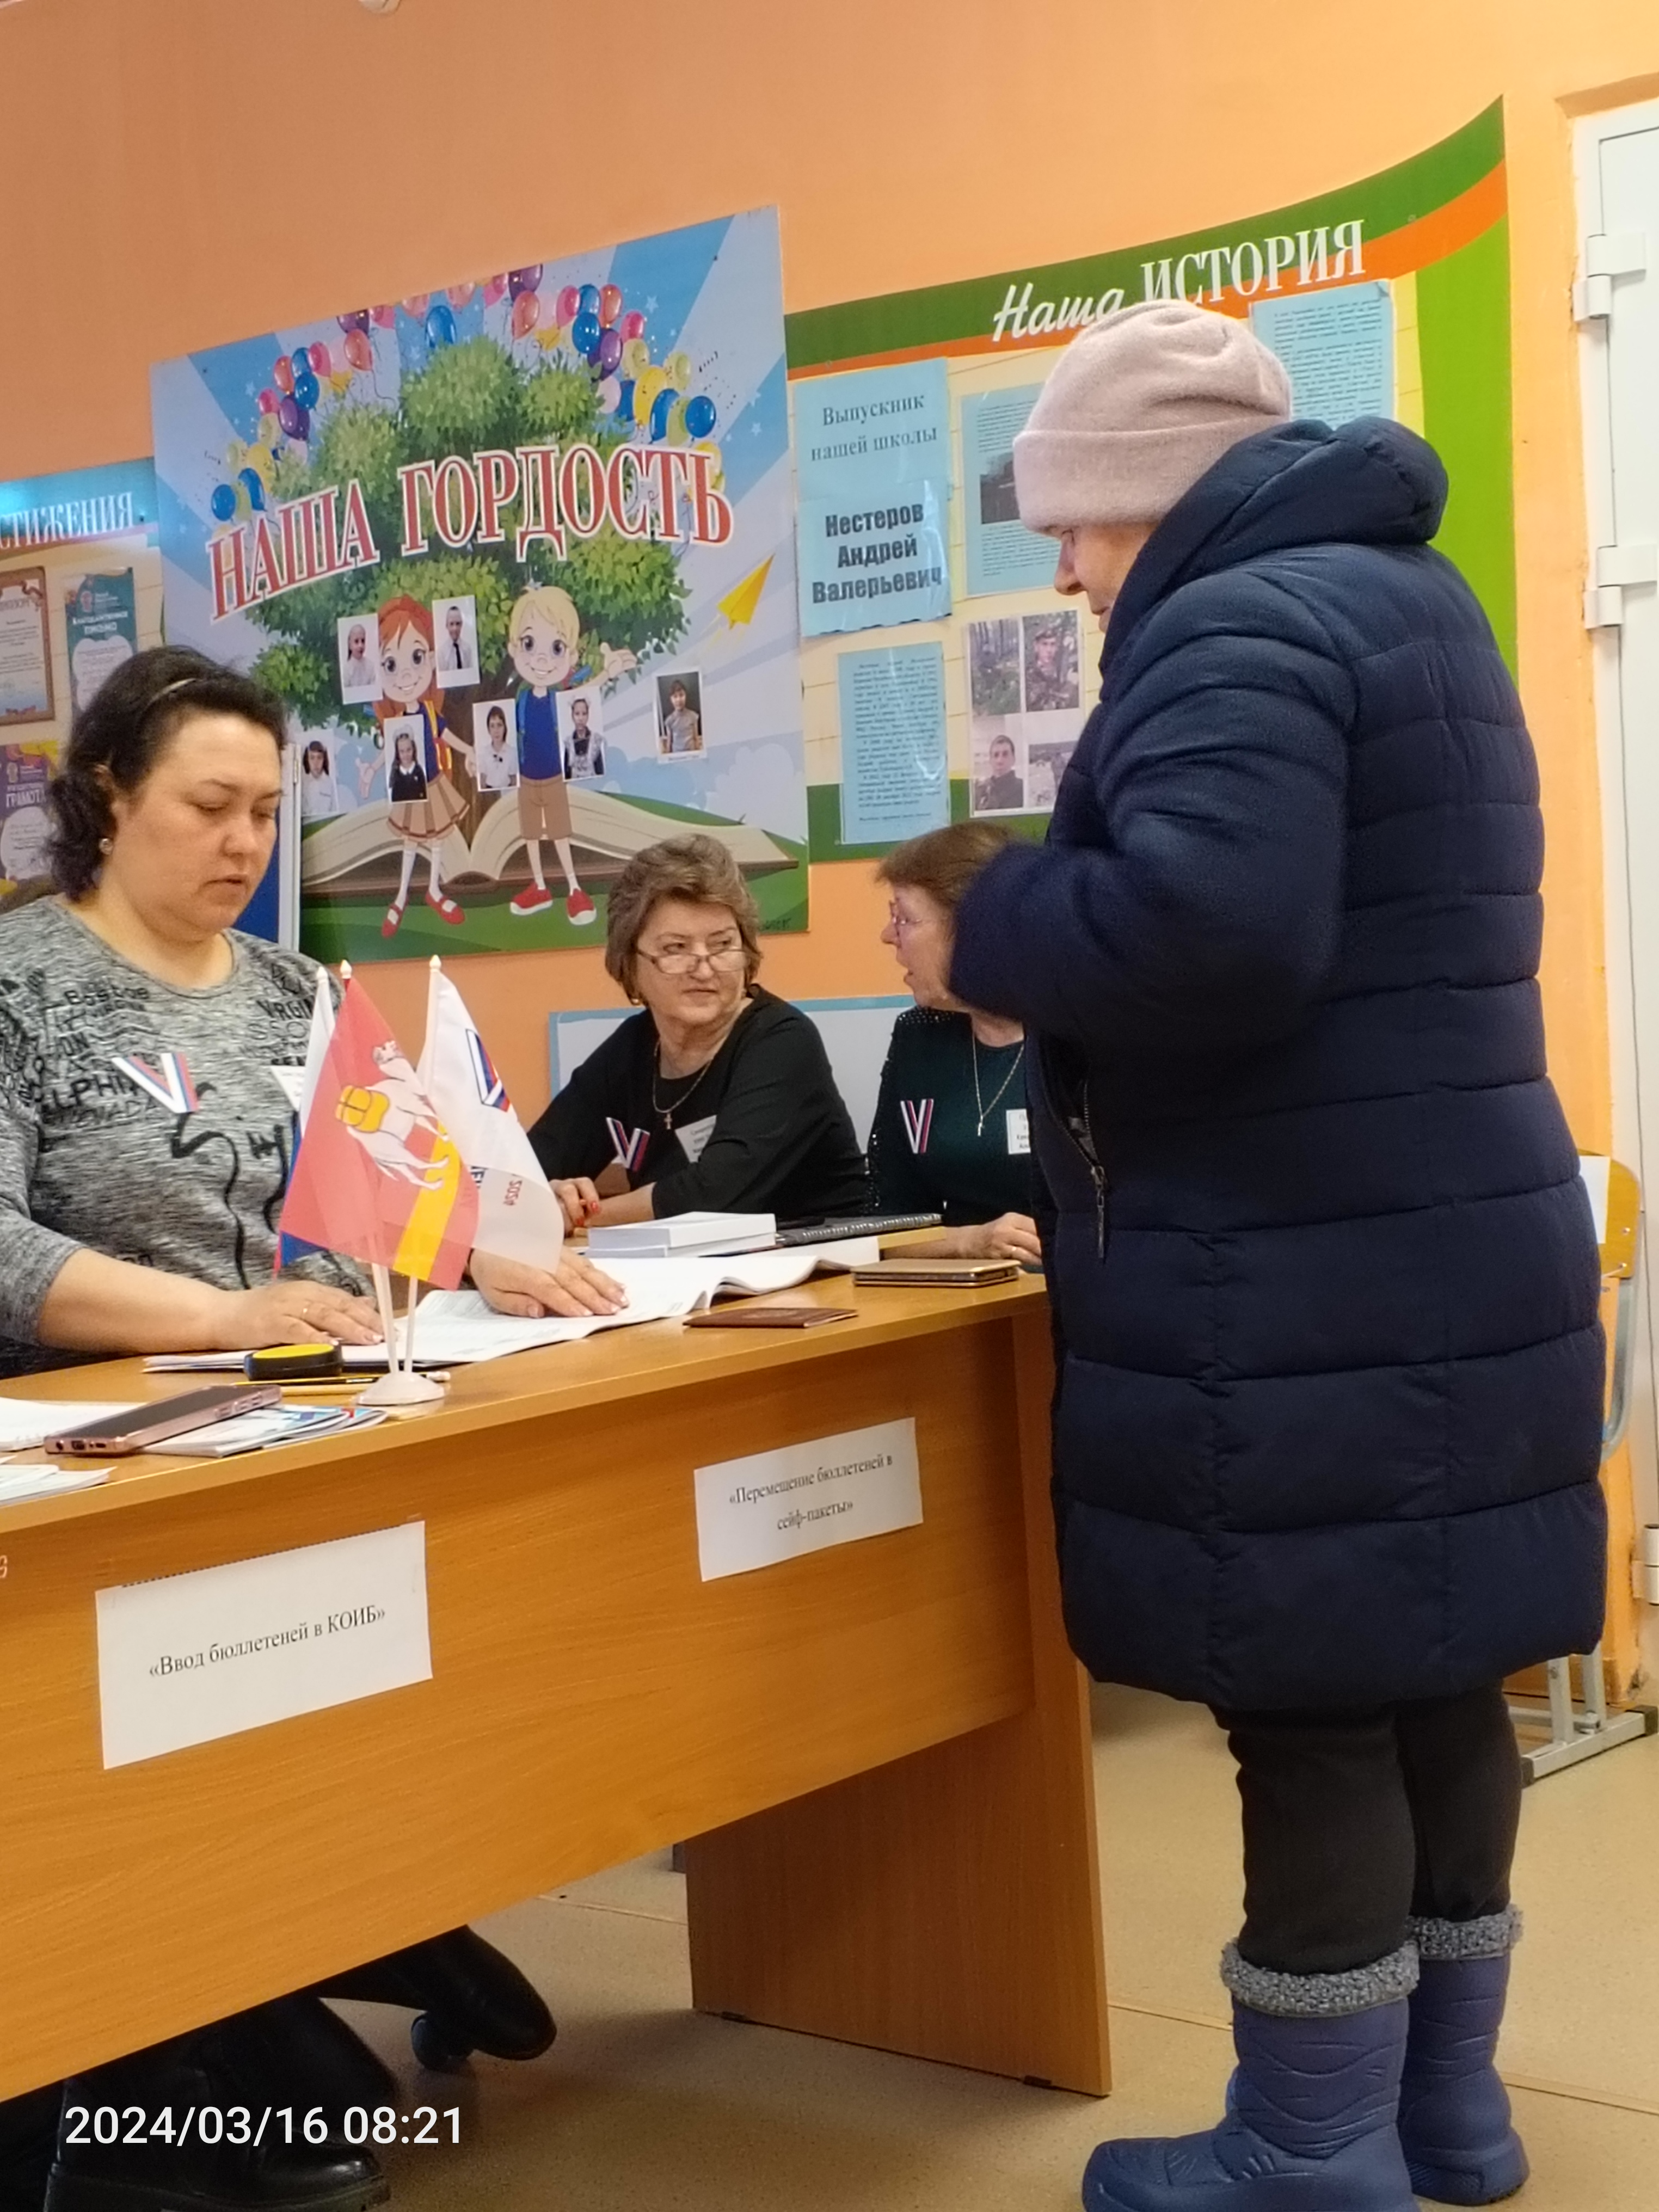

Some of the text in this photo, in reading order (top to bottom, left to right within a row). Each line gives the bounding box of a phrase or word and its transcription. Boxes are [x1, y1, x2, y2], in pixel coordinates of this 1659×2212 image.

[992, 219, 1366, 343] Наша ИСТОРИЯ
[822, 395, 925, 426] Выпускник
[811, 427, 937, 462] нашей школы
[206, 443, 734, 624] НАША ГОРДОСТЬ
[825, 503, 924, 538] Нестеров
[837, 533, 918, 568] Андрей
[812, 567, 942, 605] Валерьевич
[730, 1454, 893, 1504] «Перемещение бюллетеней в
[777, 1500, 853, 1530] сейф-пакеты»
[149, 1605, 386, 1678] «Ввод бюллетеней в КОИБ»
